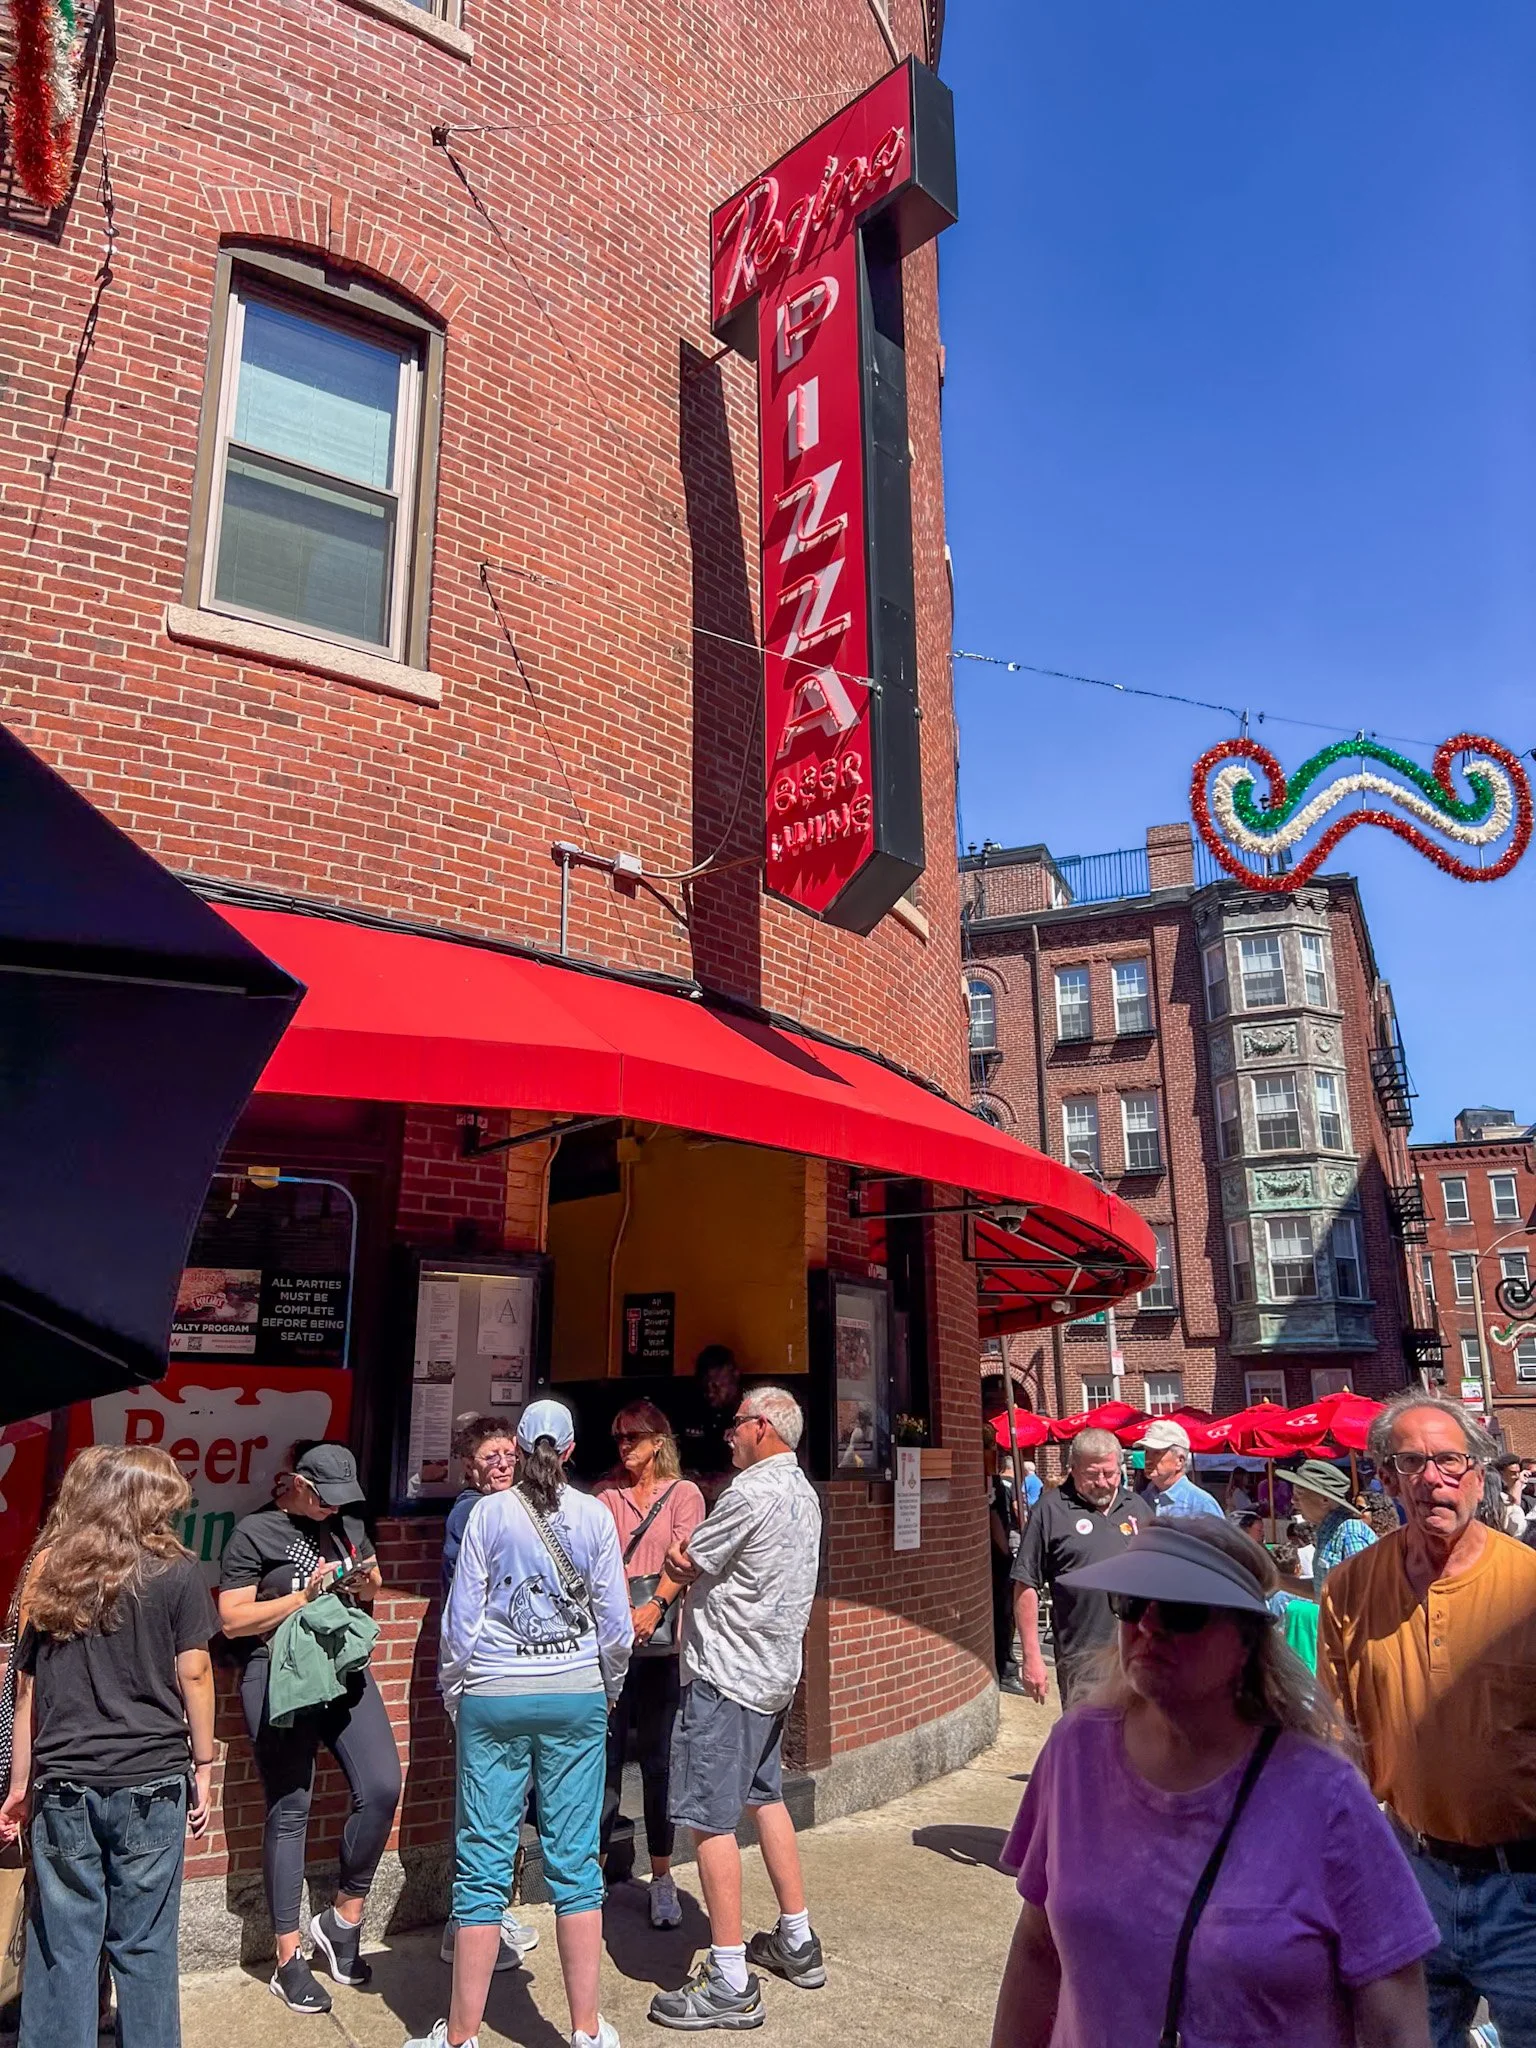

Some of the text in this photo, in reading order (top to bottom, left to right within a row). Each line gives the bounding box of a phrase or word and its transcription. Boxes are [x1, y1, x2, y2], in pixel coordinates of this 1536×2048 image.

[716, 125, 906, 306] Regina
[773, 275, 862, 760] PIZZA
[774, 750, 863, 811] BEER
[271, 1278, 342, 1290] ALL PARTIES
[280, 1292, 329, 1303] MUST BE
[274, 1305, 335, 1316] COMPLETE
[499, 1298, 518, 1325] A
[202, 1324, 250, 1333] PROGRAM
[261, 1318, 345, 1330] BEFORE BEING
[280, 1332, 324, 1342] SEATED
